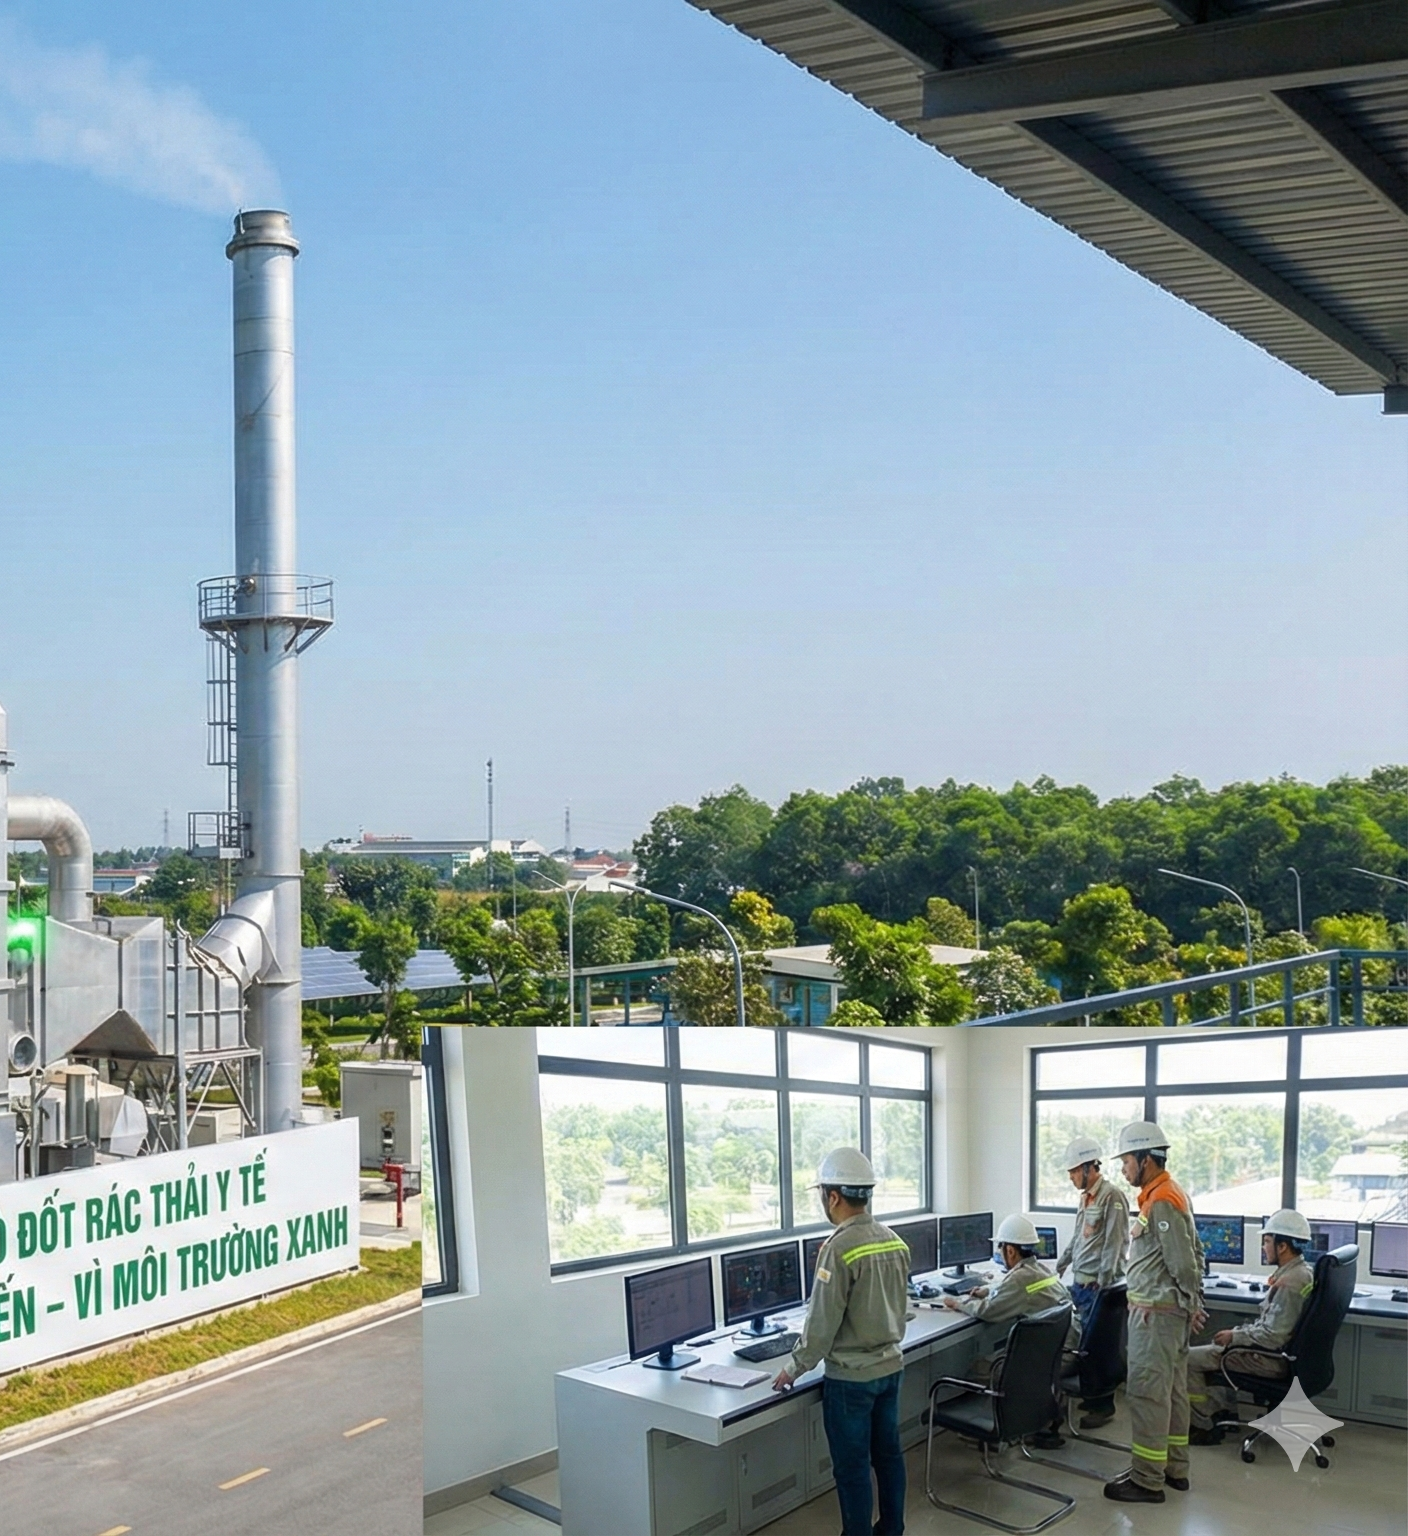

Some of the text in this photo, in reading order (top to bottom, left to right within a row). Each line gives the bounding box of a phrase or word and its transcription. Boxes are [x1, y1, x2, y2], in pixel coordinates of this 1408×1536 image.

[17, 1188, 76, 1260] ĐỐT
[86, 1182, 142, 1244] RÁC
[150, 1161, 209, 1227] THẢI
[215, 1170, 233, 1211] Y
[239, 1147, 268, 1206] TẾ
[73, 1258, 103, 1320] VÌ
[113, 1245, 168, 1310] MÔI
[176, 1222, 280, 1290] TRƯỜNG
[285, 1205, 350, 1260] XANH
